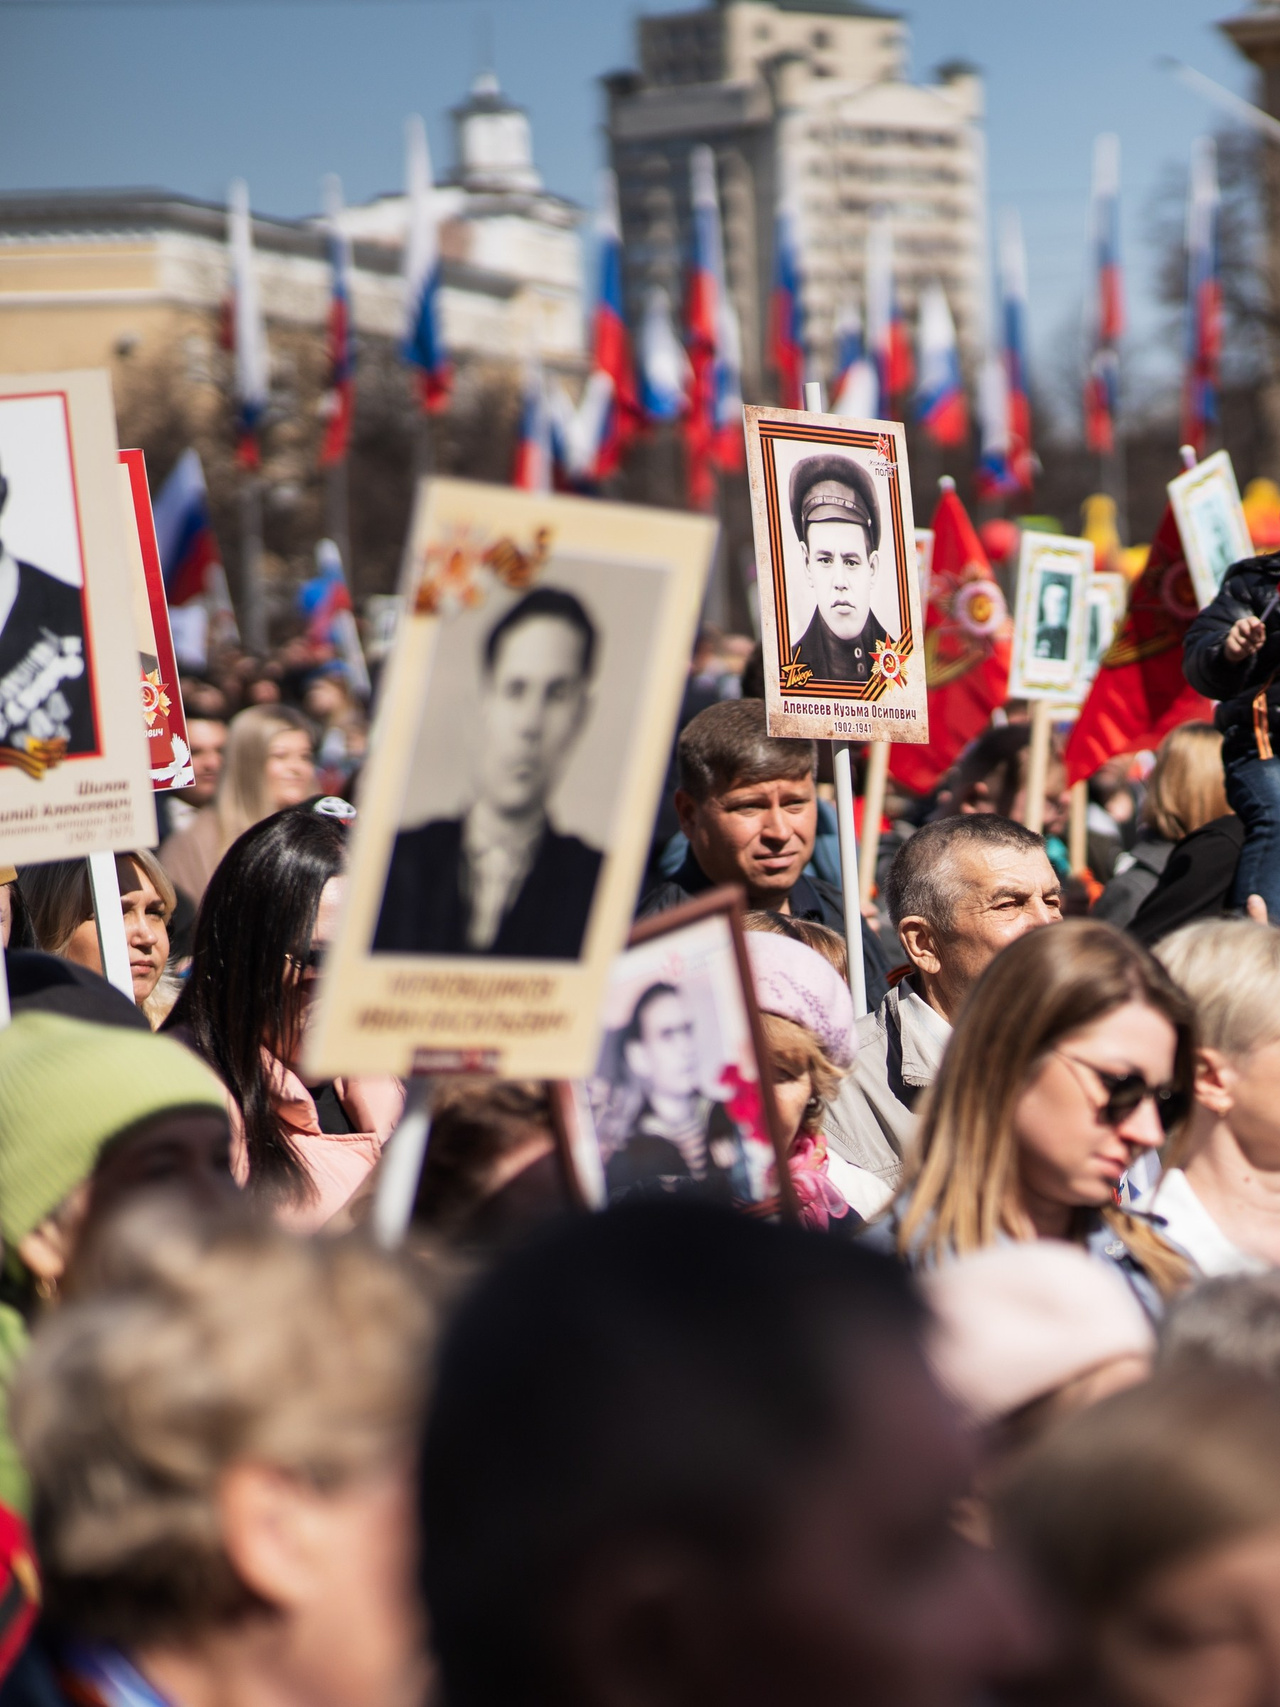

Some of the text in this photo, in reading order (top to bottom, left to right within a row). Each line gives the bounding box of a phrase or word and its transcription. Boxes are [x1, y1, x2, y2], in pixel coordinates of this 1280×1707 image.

[783, 700, 917, 720] Алексеев Кузьма Осипович
[834, 721, 872, 734] 1902-1941
